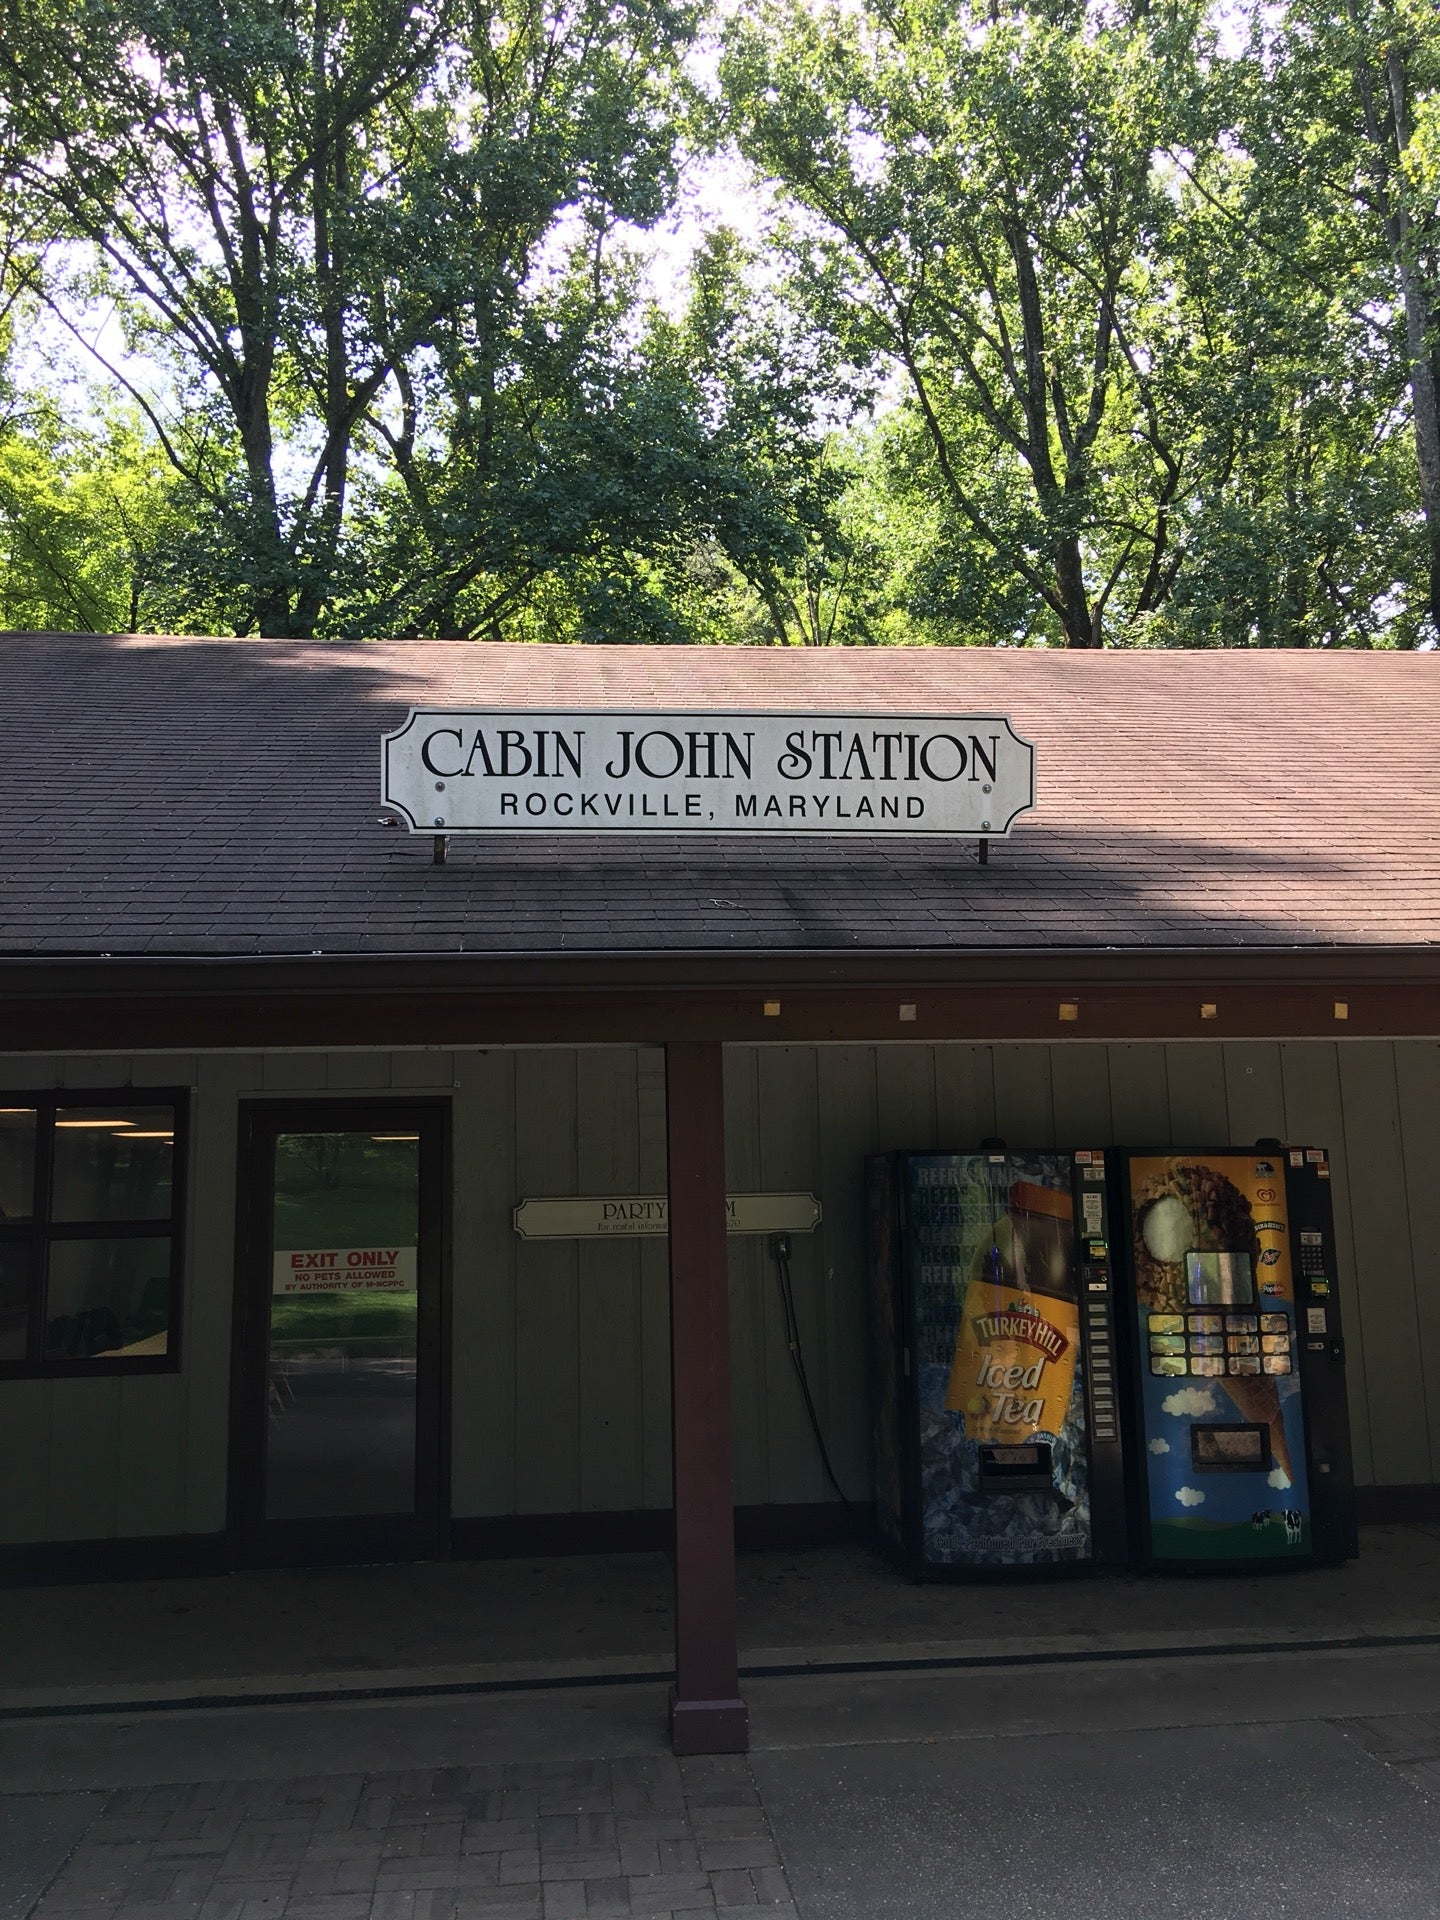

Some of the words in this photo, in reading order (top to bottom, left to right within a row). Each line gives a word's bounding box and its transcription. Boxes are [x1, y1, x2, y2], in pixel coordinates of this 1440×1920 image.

[421, 728, 586, 779] CABIN
[605, 730, 755, 780] JOHN
[777, 730, 1001, 783] STATION
[500, 792, 715, 821] ROCKVILLE,
[735, 794, 925, 819] MARYLAND
[603, 1202, 666, 1220] PARTY
[612, 1222, 635, 1231] rental
[291, 1252, 339, 1268] EXIT
[347, 1250, 400, 1267] ONLY
[285, 1283, 296, 1291] BY
[300, 1282, 348, 1290] AUTHORITY
[366, 1280, 405, 1288] M-NCPPC
[295, 1273, 310, 1281] NO
[314, 1272, 341, 1281] PETS
[345, 1270, 396, 1280] ALLOWED
[976, 1316, 1037, 1339] TURKEY
[1034, 1322, 1062, 1357] HILL
[976, 1354, 1046, 1390] Iced
[991, 1392, 1045, 1426] Tea
